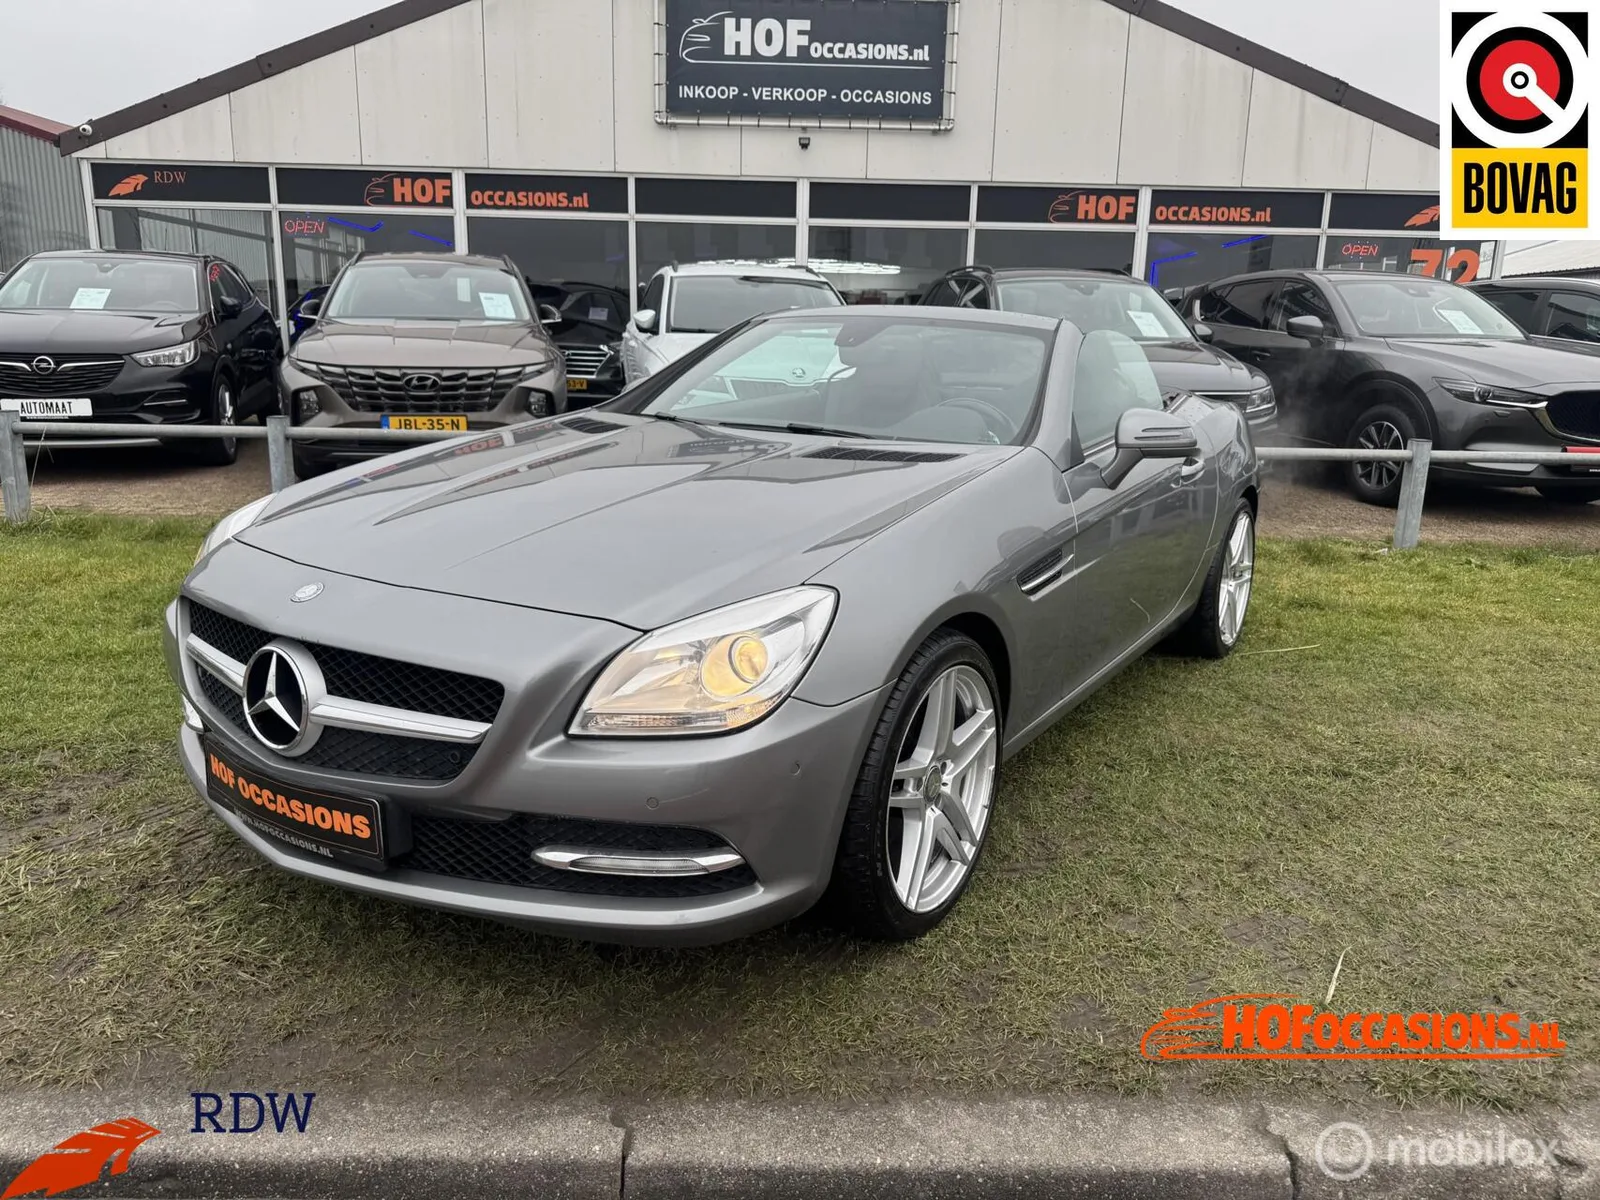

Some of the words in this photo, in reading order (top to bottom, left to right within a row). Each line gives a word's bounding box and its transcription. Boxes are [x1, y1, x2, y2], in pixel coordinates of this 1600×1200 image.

[678, 85, 739, 100] INKOOP
[751, 87, 828, 102] VERKOOP
[840, 89, 932, 105] OCCASIONS
[153, 171, 188, 184] RDW
[392, 177, 452, 204] HOF
[470, 190, 589, 209] OCCASIONS.nl
[1076, 195, 1136, 221] HOF
[1155, 206, 1272, 223] OCCASIONS.nl
[284, 219, 325, 234] OPEN
[1341, 242, 1379, 257] OPEN
[20, 401, 73, 415] AUTOMAAT
[395, 418, 461, 431] JBL-35-N
[209, 753, 235, 789] HOF
[237, 776, 371, 839] OCCASIONS
